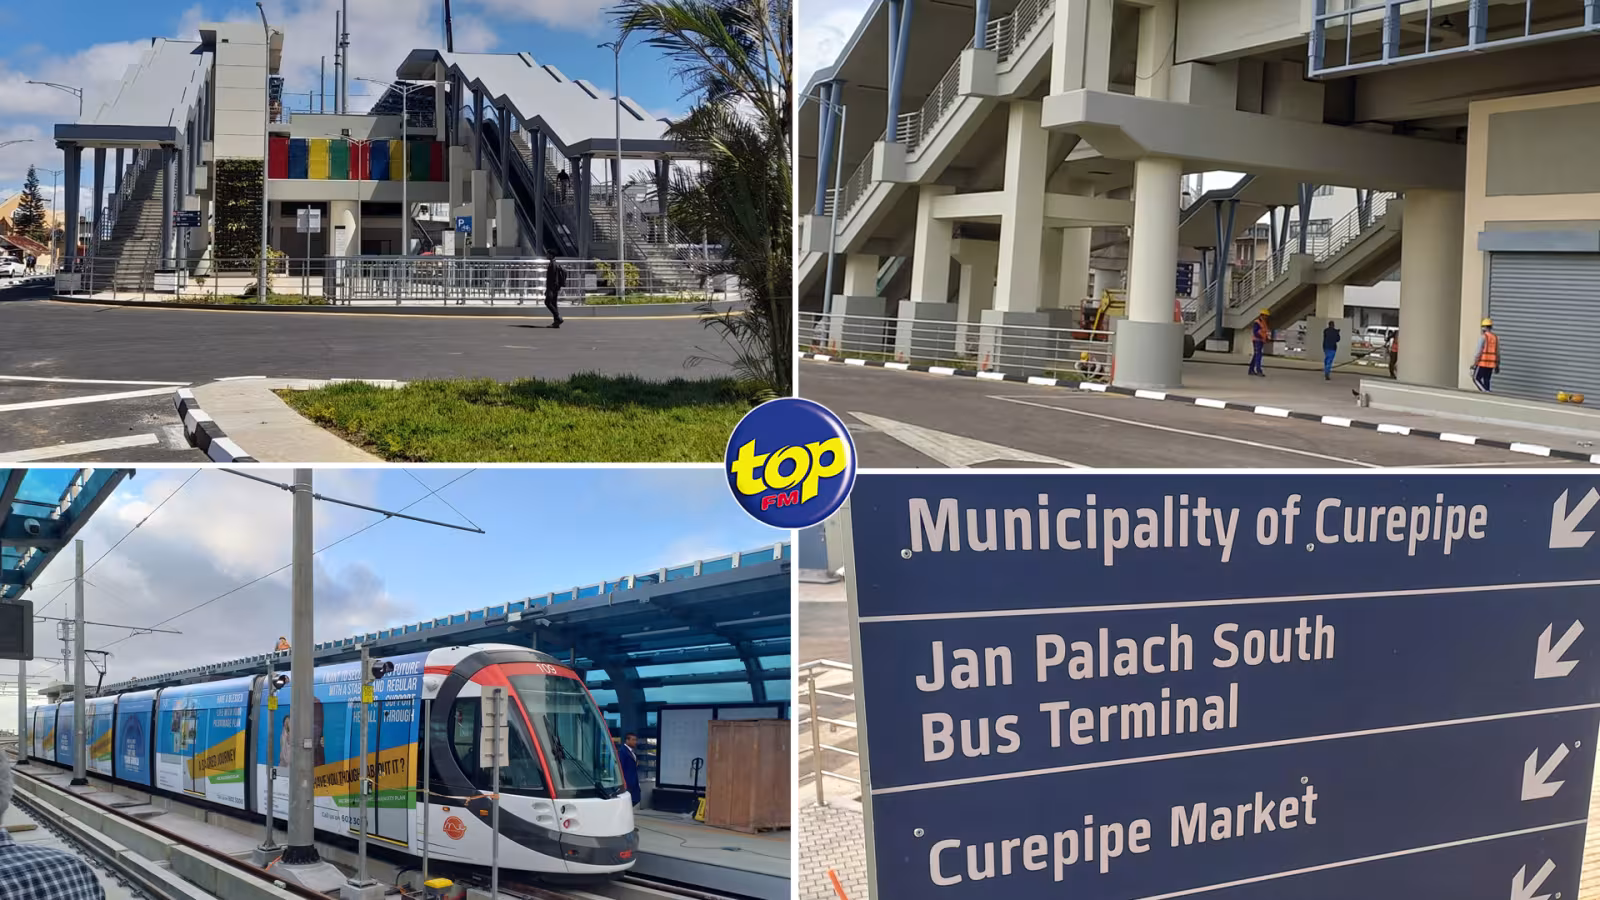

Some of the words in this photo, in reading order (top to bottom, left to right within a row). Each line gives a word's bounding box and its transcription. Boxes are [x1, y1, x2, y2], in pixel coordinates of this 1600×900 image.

[458, 218, 465, 228] P
[908, 493, 1240, 567] Municipality
[1256, 493, 1302, 546] of
[1315, 493, 1488, 557] Curepipe
[915, 640, 1013, 692] Jan
[1036, 627, 1193, 683] Palach
[1212, 614, 1335, 668] South
[393, 661, 420, 677] FUTURE
[536, 663, 557, 674] 109
[347, 682, 361, 695] STAB
[373, 680, 384, 693] AND
[386, 677, 417, 692] REGULAR
[385, 694, 416, 707] SUPPORT
[383, 708, 415, 723] THROUGH
[921, 712, 1021, 762] Bus
[1039, 682, 1239, 748] Terminal
[217, 748, 236, 766] JOURNEY
[338, 768, 361, 786] THOUGH
[400, 758, 404, 773] ?
[929, 814, 1151, 886] Curepipe
[1170, 785, 1318, 847] Market
